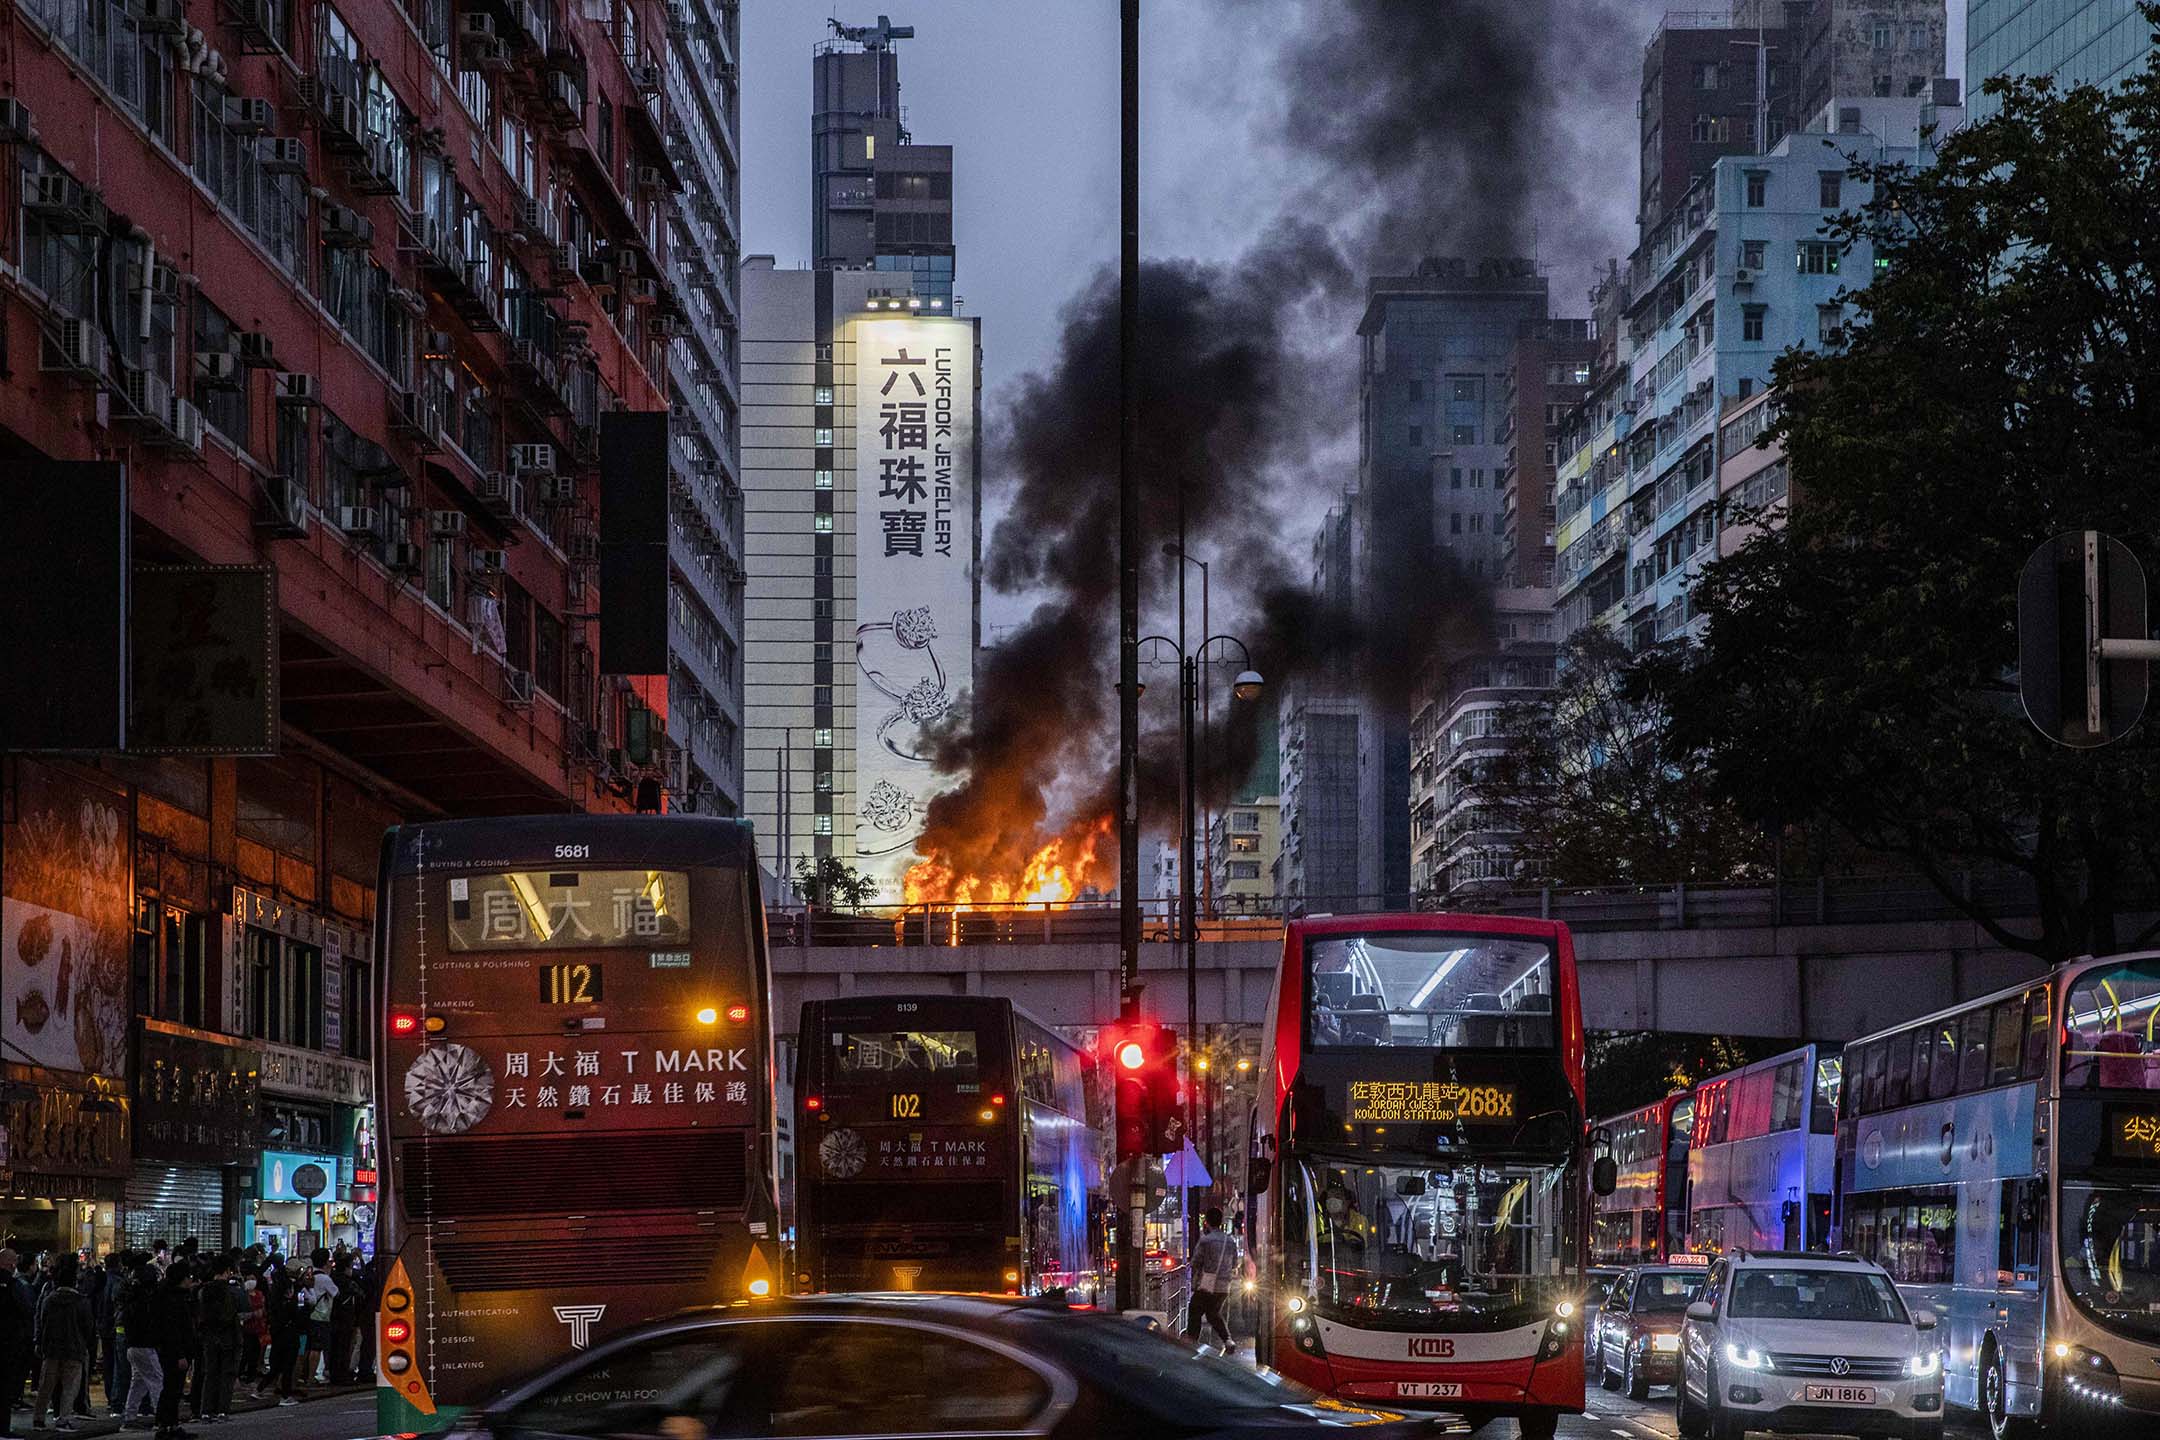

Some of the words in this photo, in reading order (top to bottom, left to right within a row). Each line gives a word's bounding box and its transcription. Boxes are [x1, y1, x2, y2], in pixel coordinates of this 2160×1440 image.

[935, 348, 951, 437] LUKFOOK
[879, 348, 927, 558] 六福珠寶
[935, 444, 951, 558] JEWELLERY
[555, 845, 589, 858] 5681
[430, 860, 463, 868] BUYING
[474, 859, 512, 868] CODING
[481, 888, 660, 941] 周大福
[432, 961, 471, 970] CUTTING
[483, 960, 531, 969] POLISHING
[551, 964, 593, 1004] 112
[433, 1000, 475, 1009] MARKING
[897, 1003, 918, 1012] 8139
[504, 1050, 600, 1078] 周大福
[621, 1050, 639, 1074] T
[656, 1048, 748, 1073] MARK
[1350, 1081, 1459, 1100] 佐敦西九龍站
[893, 1094, 920, 1118] 102
[1367, 1101, 1406, 1110] JORDAN
[1354, 1110, 1400, 1120] KOWLOON
[880, 1140, 922, 1153] 周大福
[930, 1141, 940, 1152] T
[945, 1141, 986, 1152] MARK
[1672, 1255, 1706, 1264] TAXI
[441, 1308, 519, 1318] AUTHENTICATION
[441, 1335, 475, 1344] DESIGN
[1408, 1338, 1455, 1358] KMB
[442, 1361, 485, 1370] INLAYING
[1402, 1384, 1419, 1395] VT
[1426, 1384, 1458, 1396] 1237
[1815, 1388, 1833, 1400] JN
[1839, 1389, 1867, 1401] 1816
[575, 1391, 613, 1402] CHOW
[615, 1391, 631, 1401] TAI
